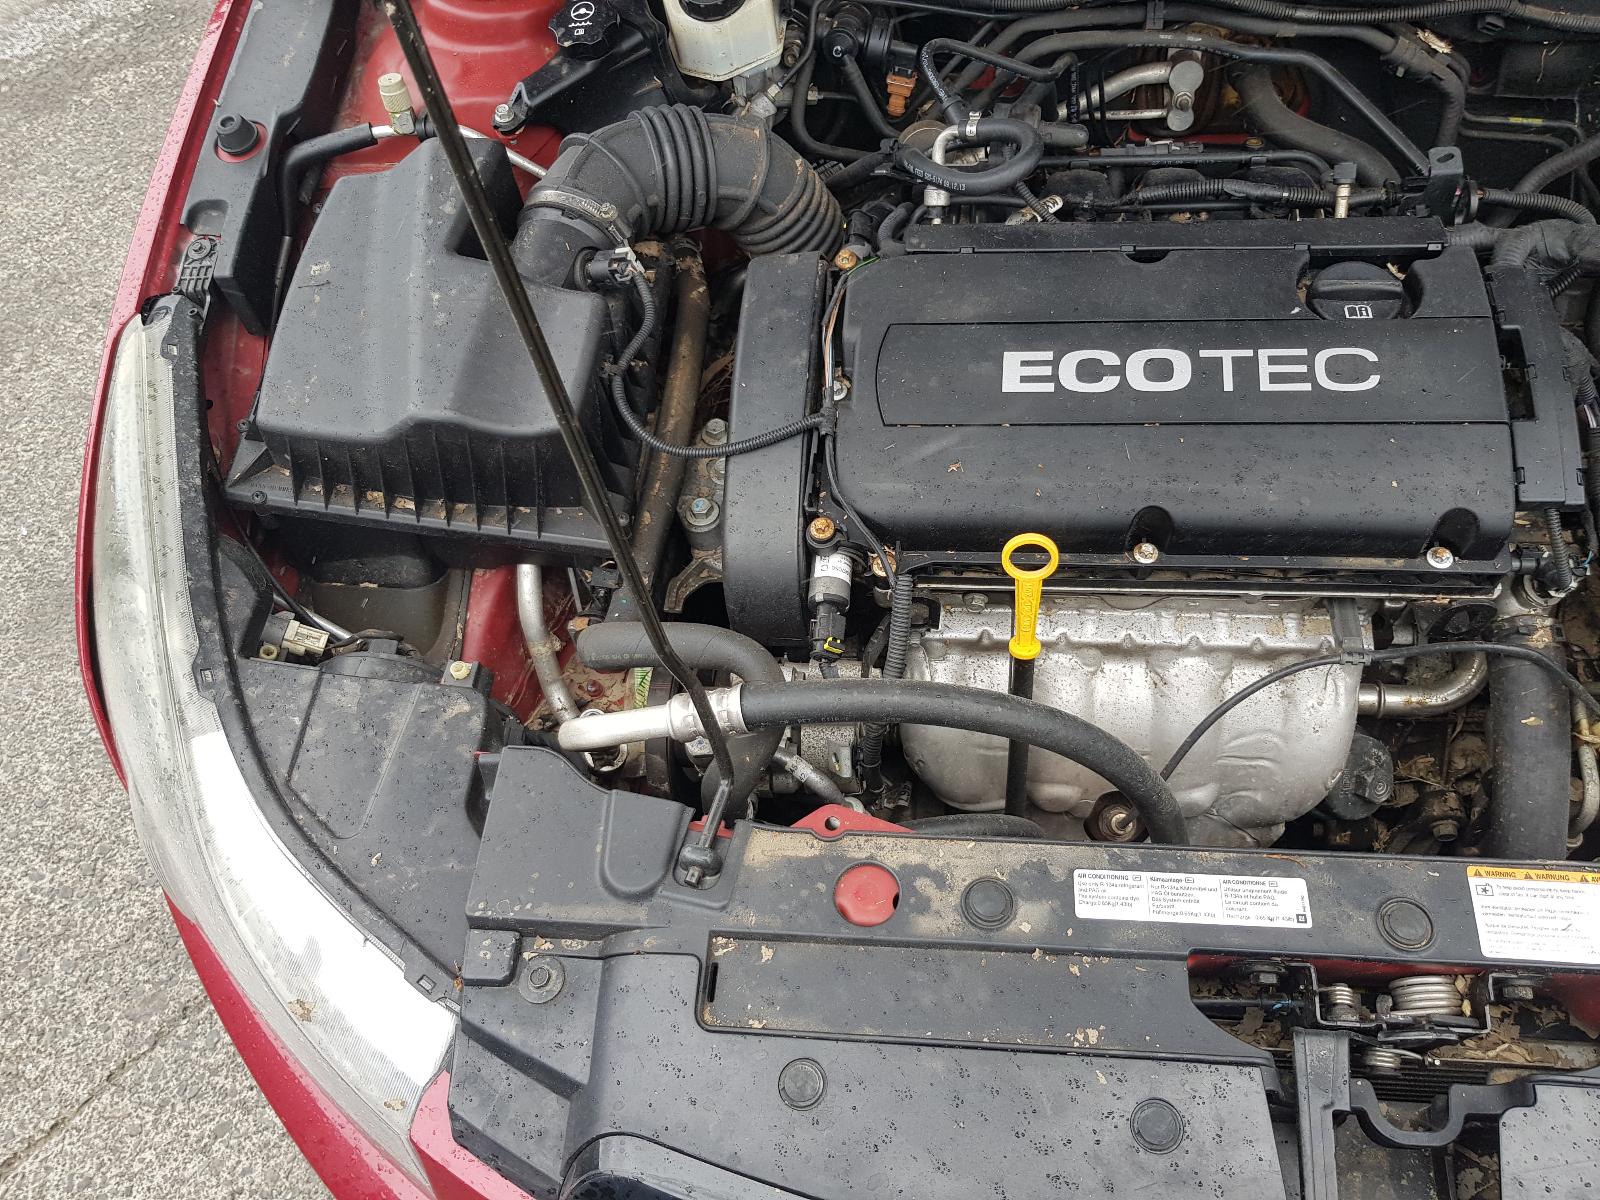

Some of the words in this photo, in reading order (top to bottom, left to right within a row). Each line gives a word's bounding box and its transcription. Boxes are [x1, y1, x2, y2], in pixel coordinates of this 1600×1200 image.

[1002, 347, 1382, 393] ECOTEC
[1088, 873, 1129, 881] CONDITIONING
[1484, 870, 1517, 879] WARNING
[1535, 873, 1570, 882] WARNUNG
